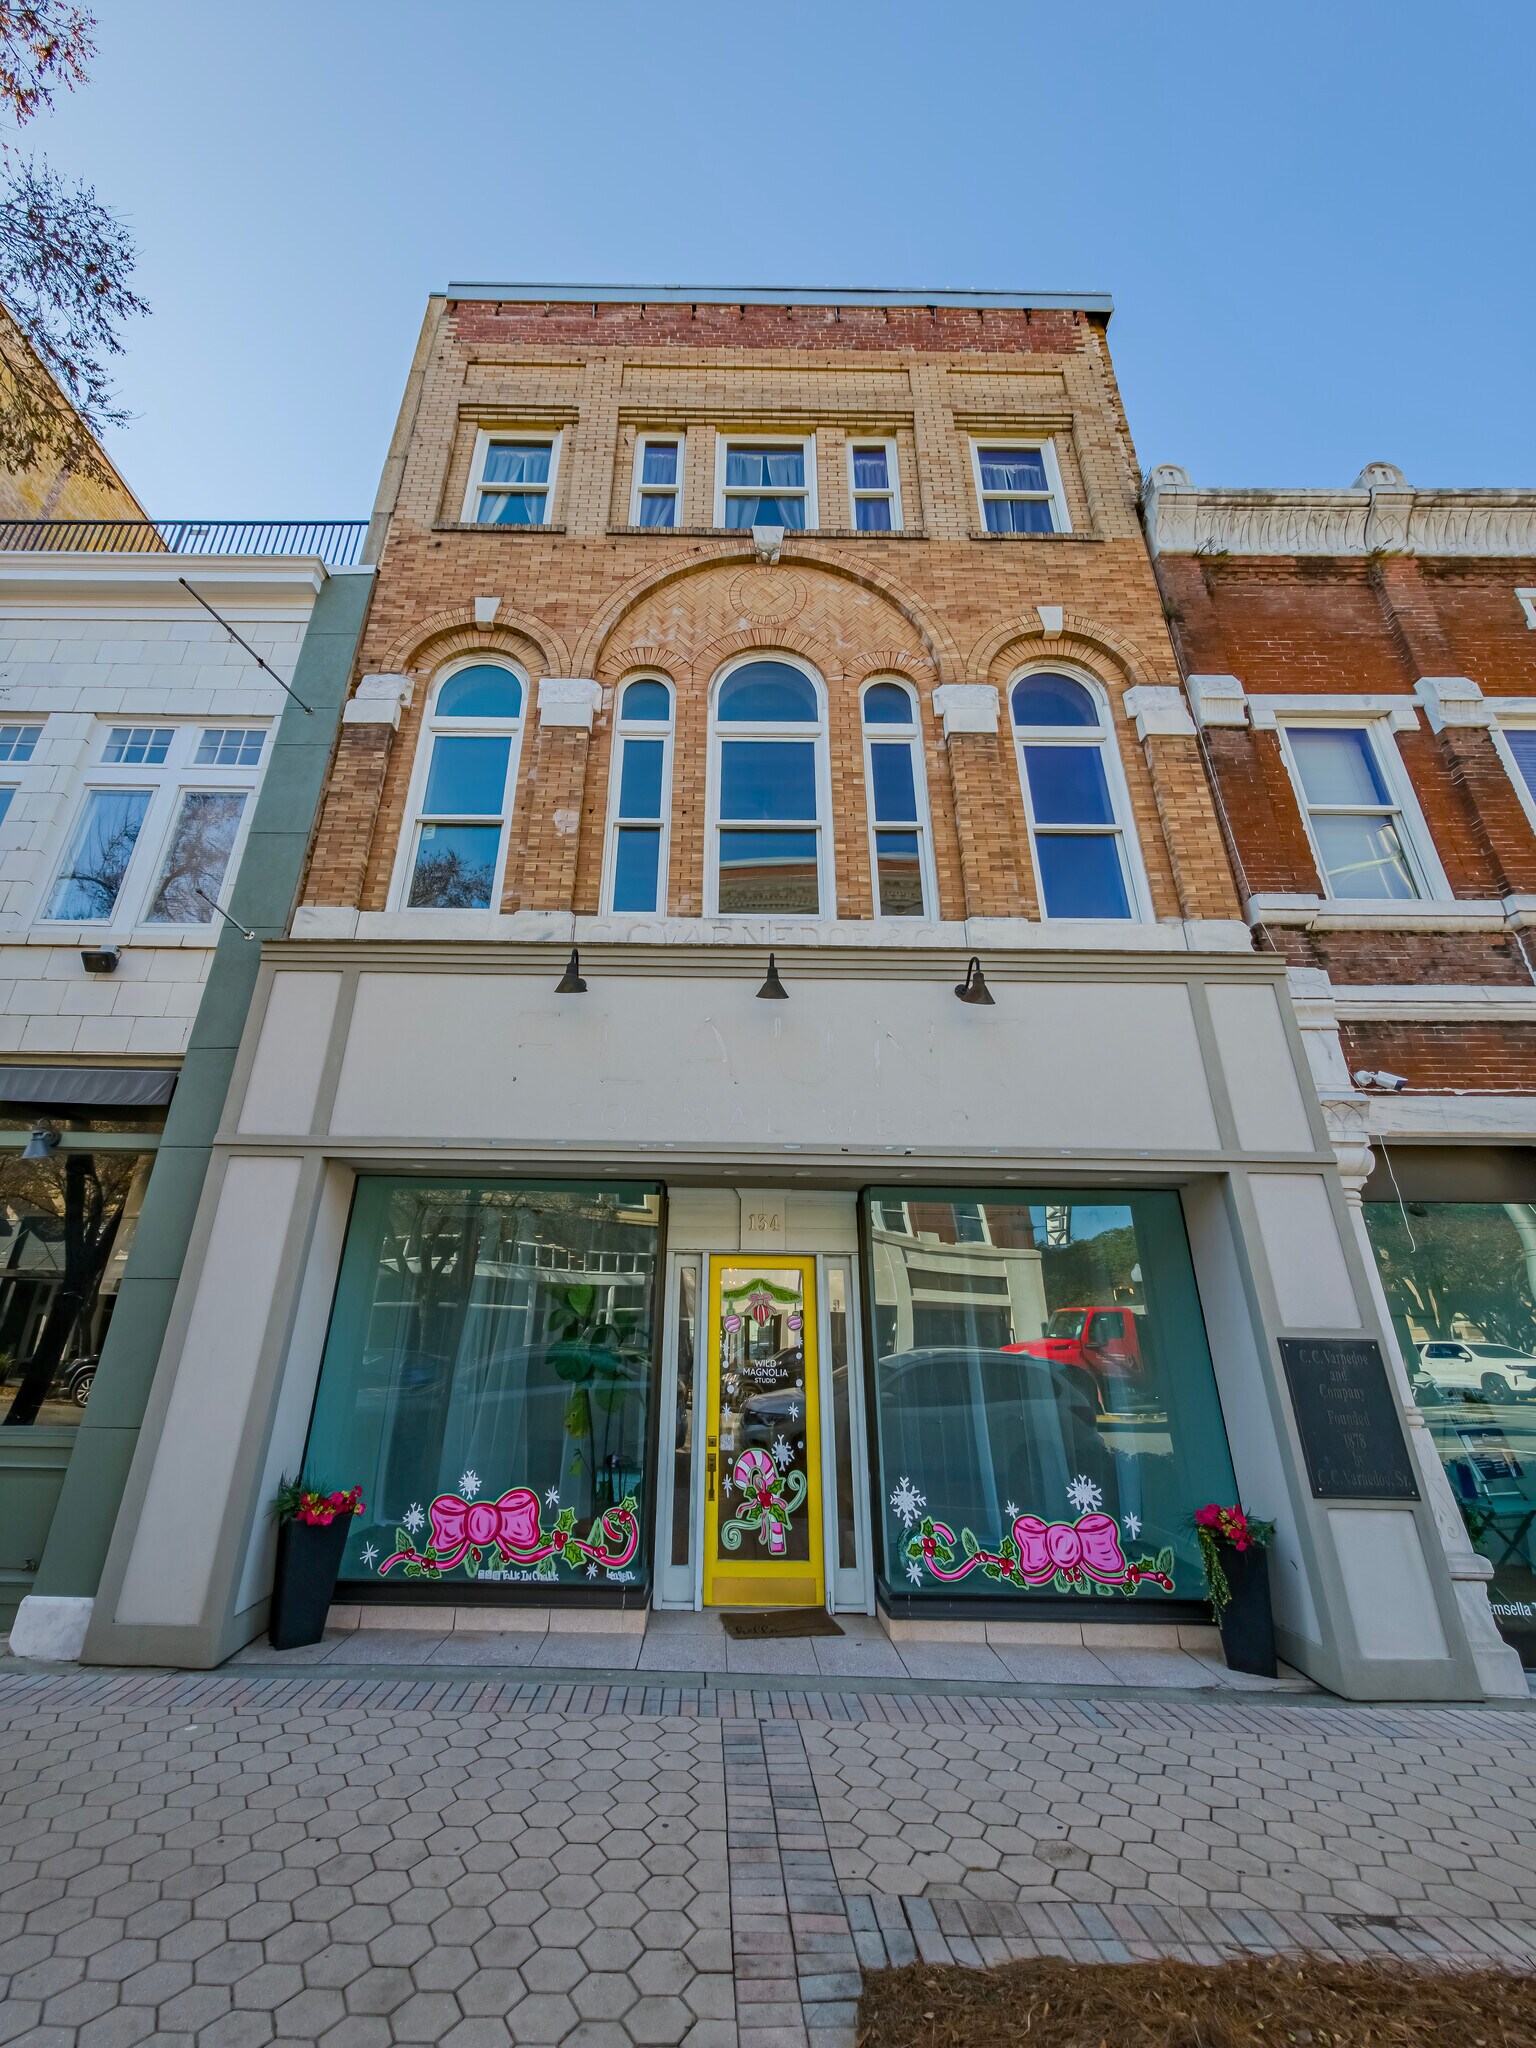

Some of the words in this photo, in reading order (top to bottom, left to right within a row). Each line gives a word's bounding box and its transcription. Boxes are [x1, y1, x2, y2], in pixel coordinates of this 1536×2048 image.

[748, 1213, 781, 1232] 134
[754, 1359, 777, 1368] WILD
[1323, 1350, 1369, 1366] Varnedoe
[742, 1367, 789, 1377] MAGNOLIA
[1330, 1367, 1348, 1382] and
[1319, 1384, 1365, 1402] Company
[1327, 1410, 1371, 1426] Founded
[1343, 1433, 1367, 1449] 1878
[1352, 1451, 1363, 1468] by
[532, 1570, 560, 1582] Chalk
